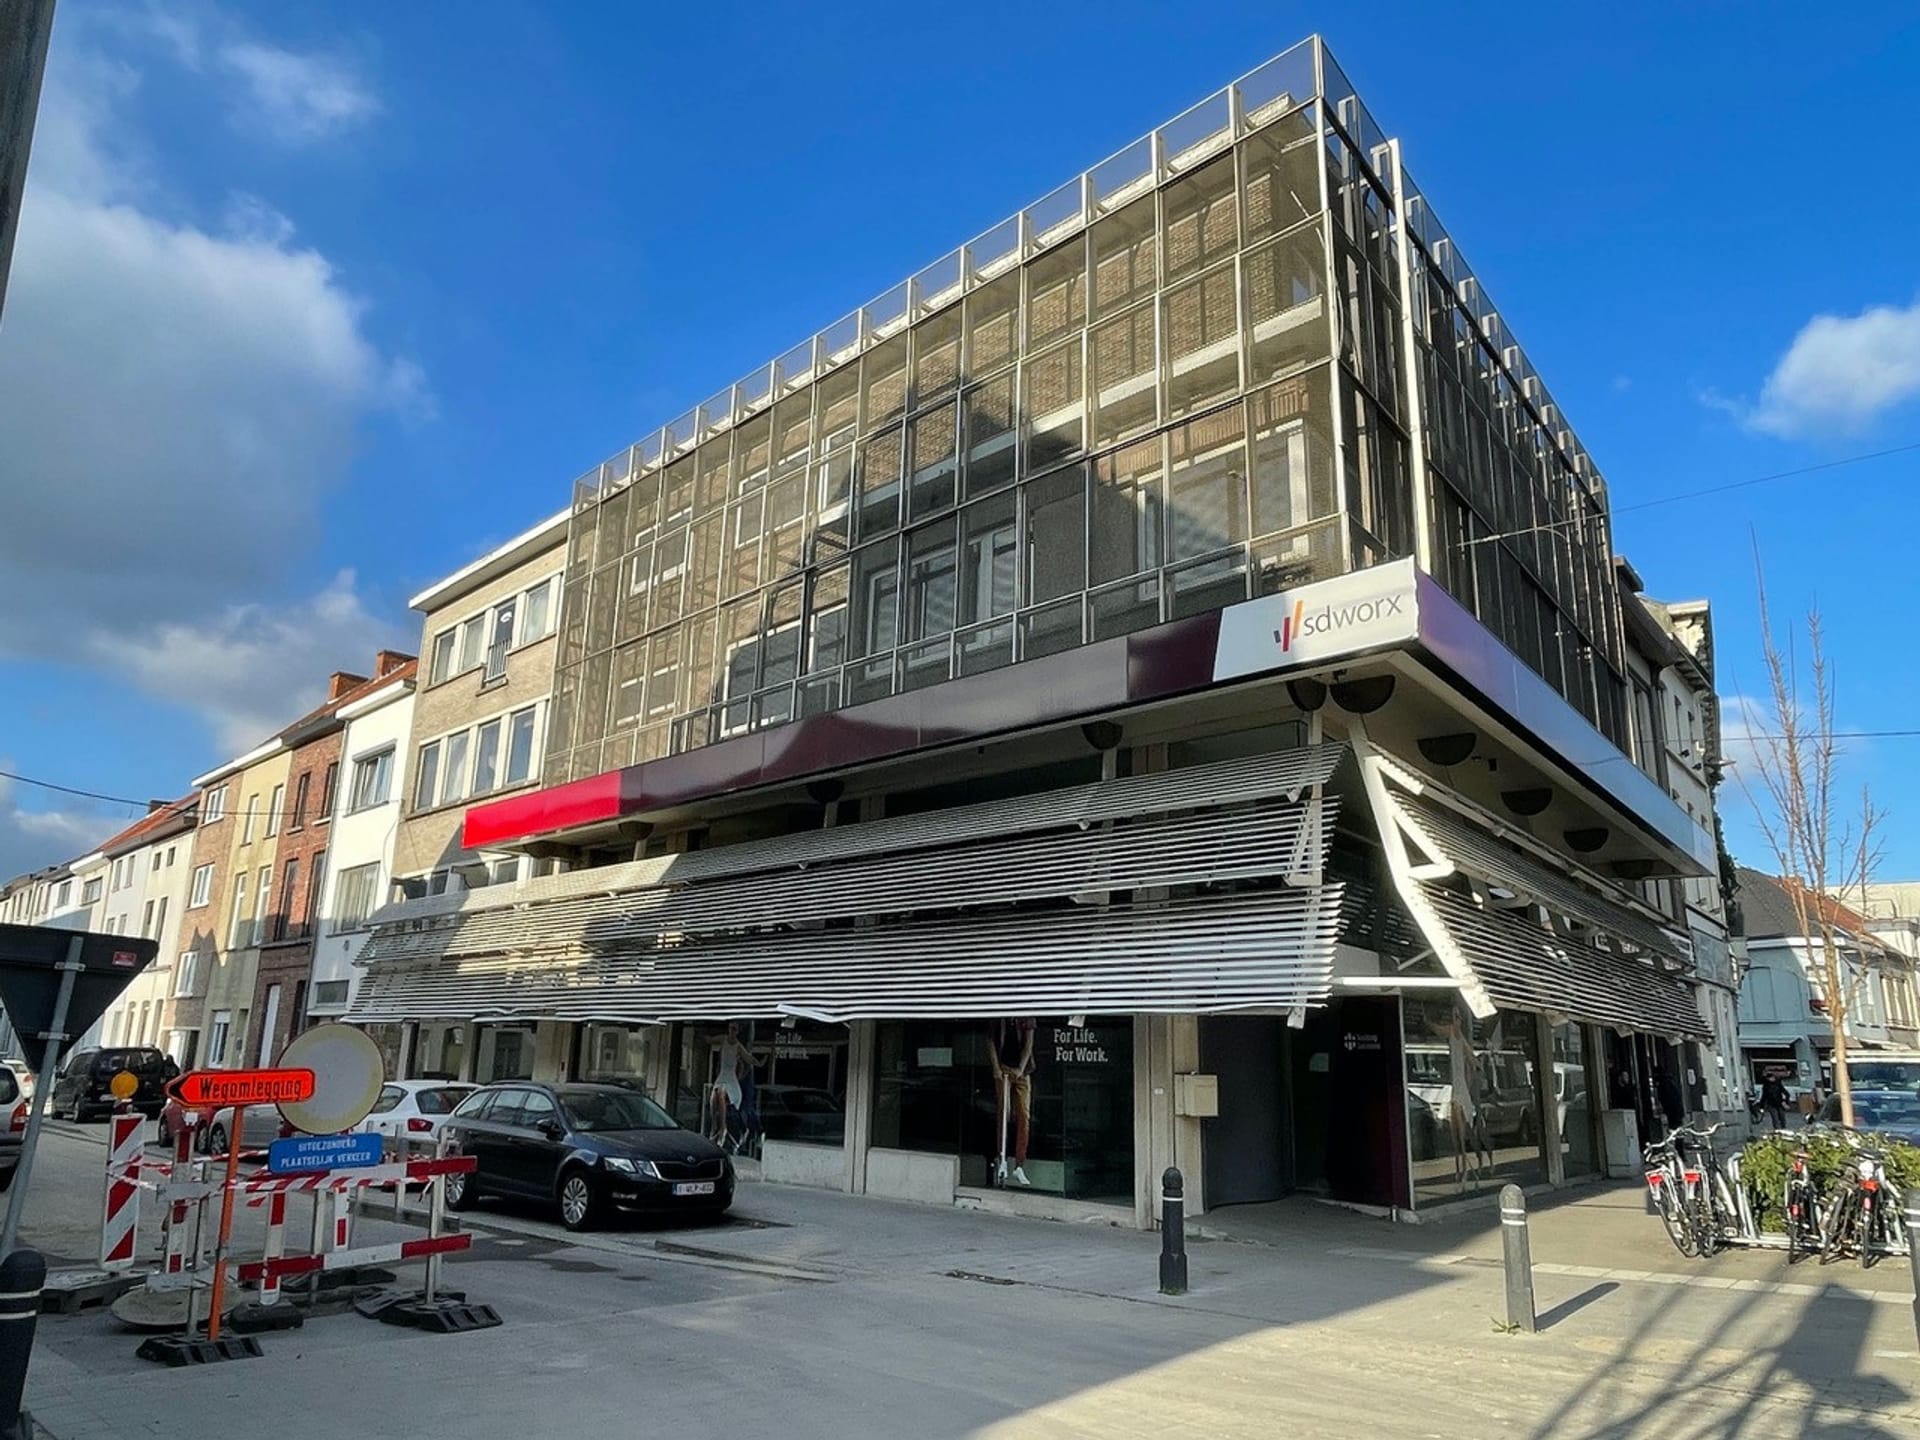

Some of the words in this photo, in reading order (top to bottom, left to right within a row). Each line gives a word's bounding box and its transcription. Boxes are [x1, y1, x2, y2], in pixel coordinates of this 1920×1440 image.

[1303, 594, 1402, 636] sdworx
[1054, 1028, 1072, 1043] For
[1073, 1028, 1098, 1043] Life.
[1055, 1046, 1074, 1061] For
[1075, 1046, 1109, 1062] Work.
[200, 1077, 302, 1105] Wegomlegging
[281, 1154, 334, 1168] PLAATSELIJK
[337, 1152, 371, 1162] VERKEER
